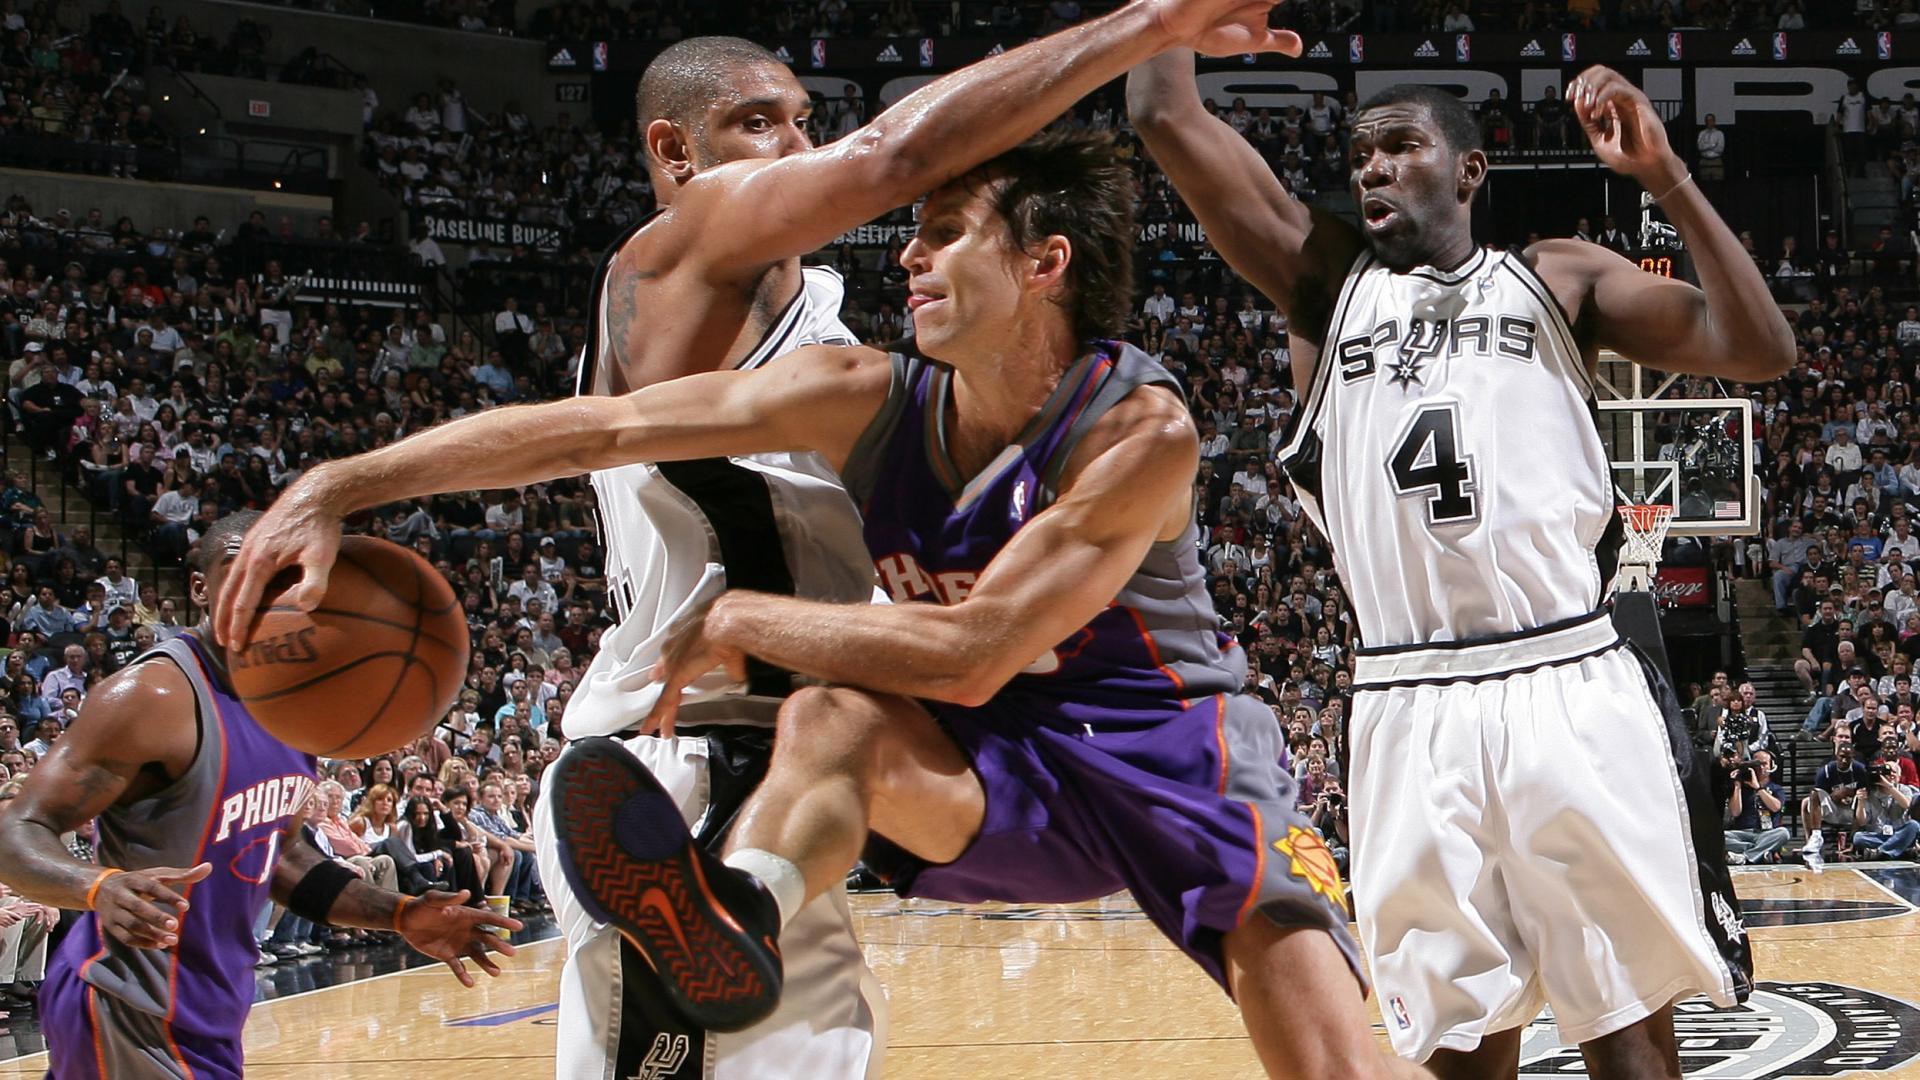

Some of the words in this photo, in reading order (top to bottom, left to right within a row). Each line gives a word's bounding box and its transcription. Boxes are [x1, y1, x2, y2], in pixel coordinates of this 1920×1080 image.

[559, 85, 585, 101] 127
[425, 215, 506, 244] BASELINE
[1338, 314, 1538, 389] SPURS
[1384, 400, 1478, 524] 4
[214, 774, 316, 843] PHOEN
[1775, 985, 1869, 1006] SAN
[1823, 1009, 1902, 1065] ANTONIO
